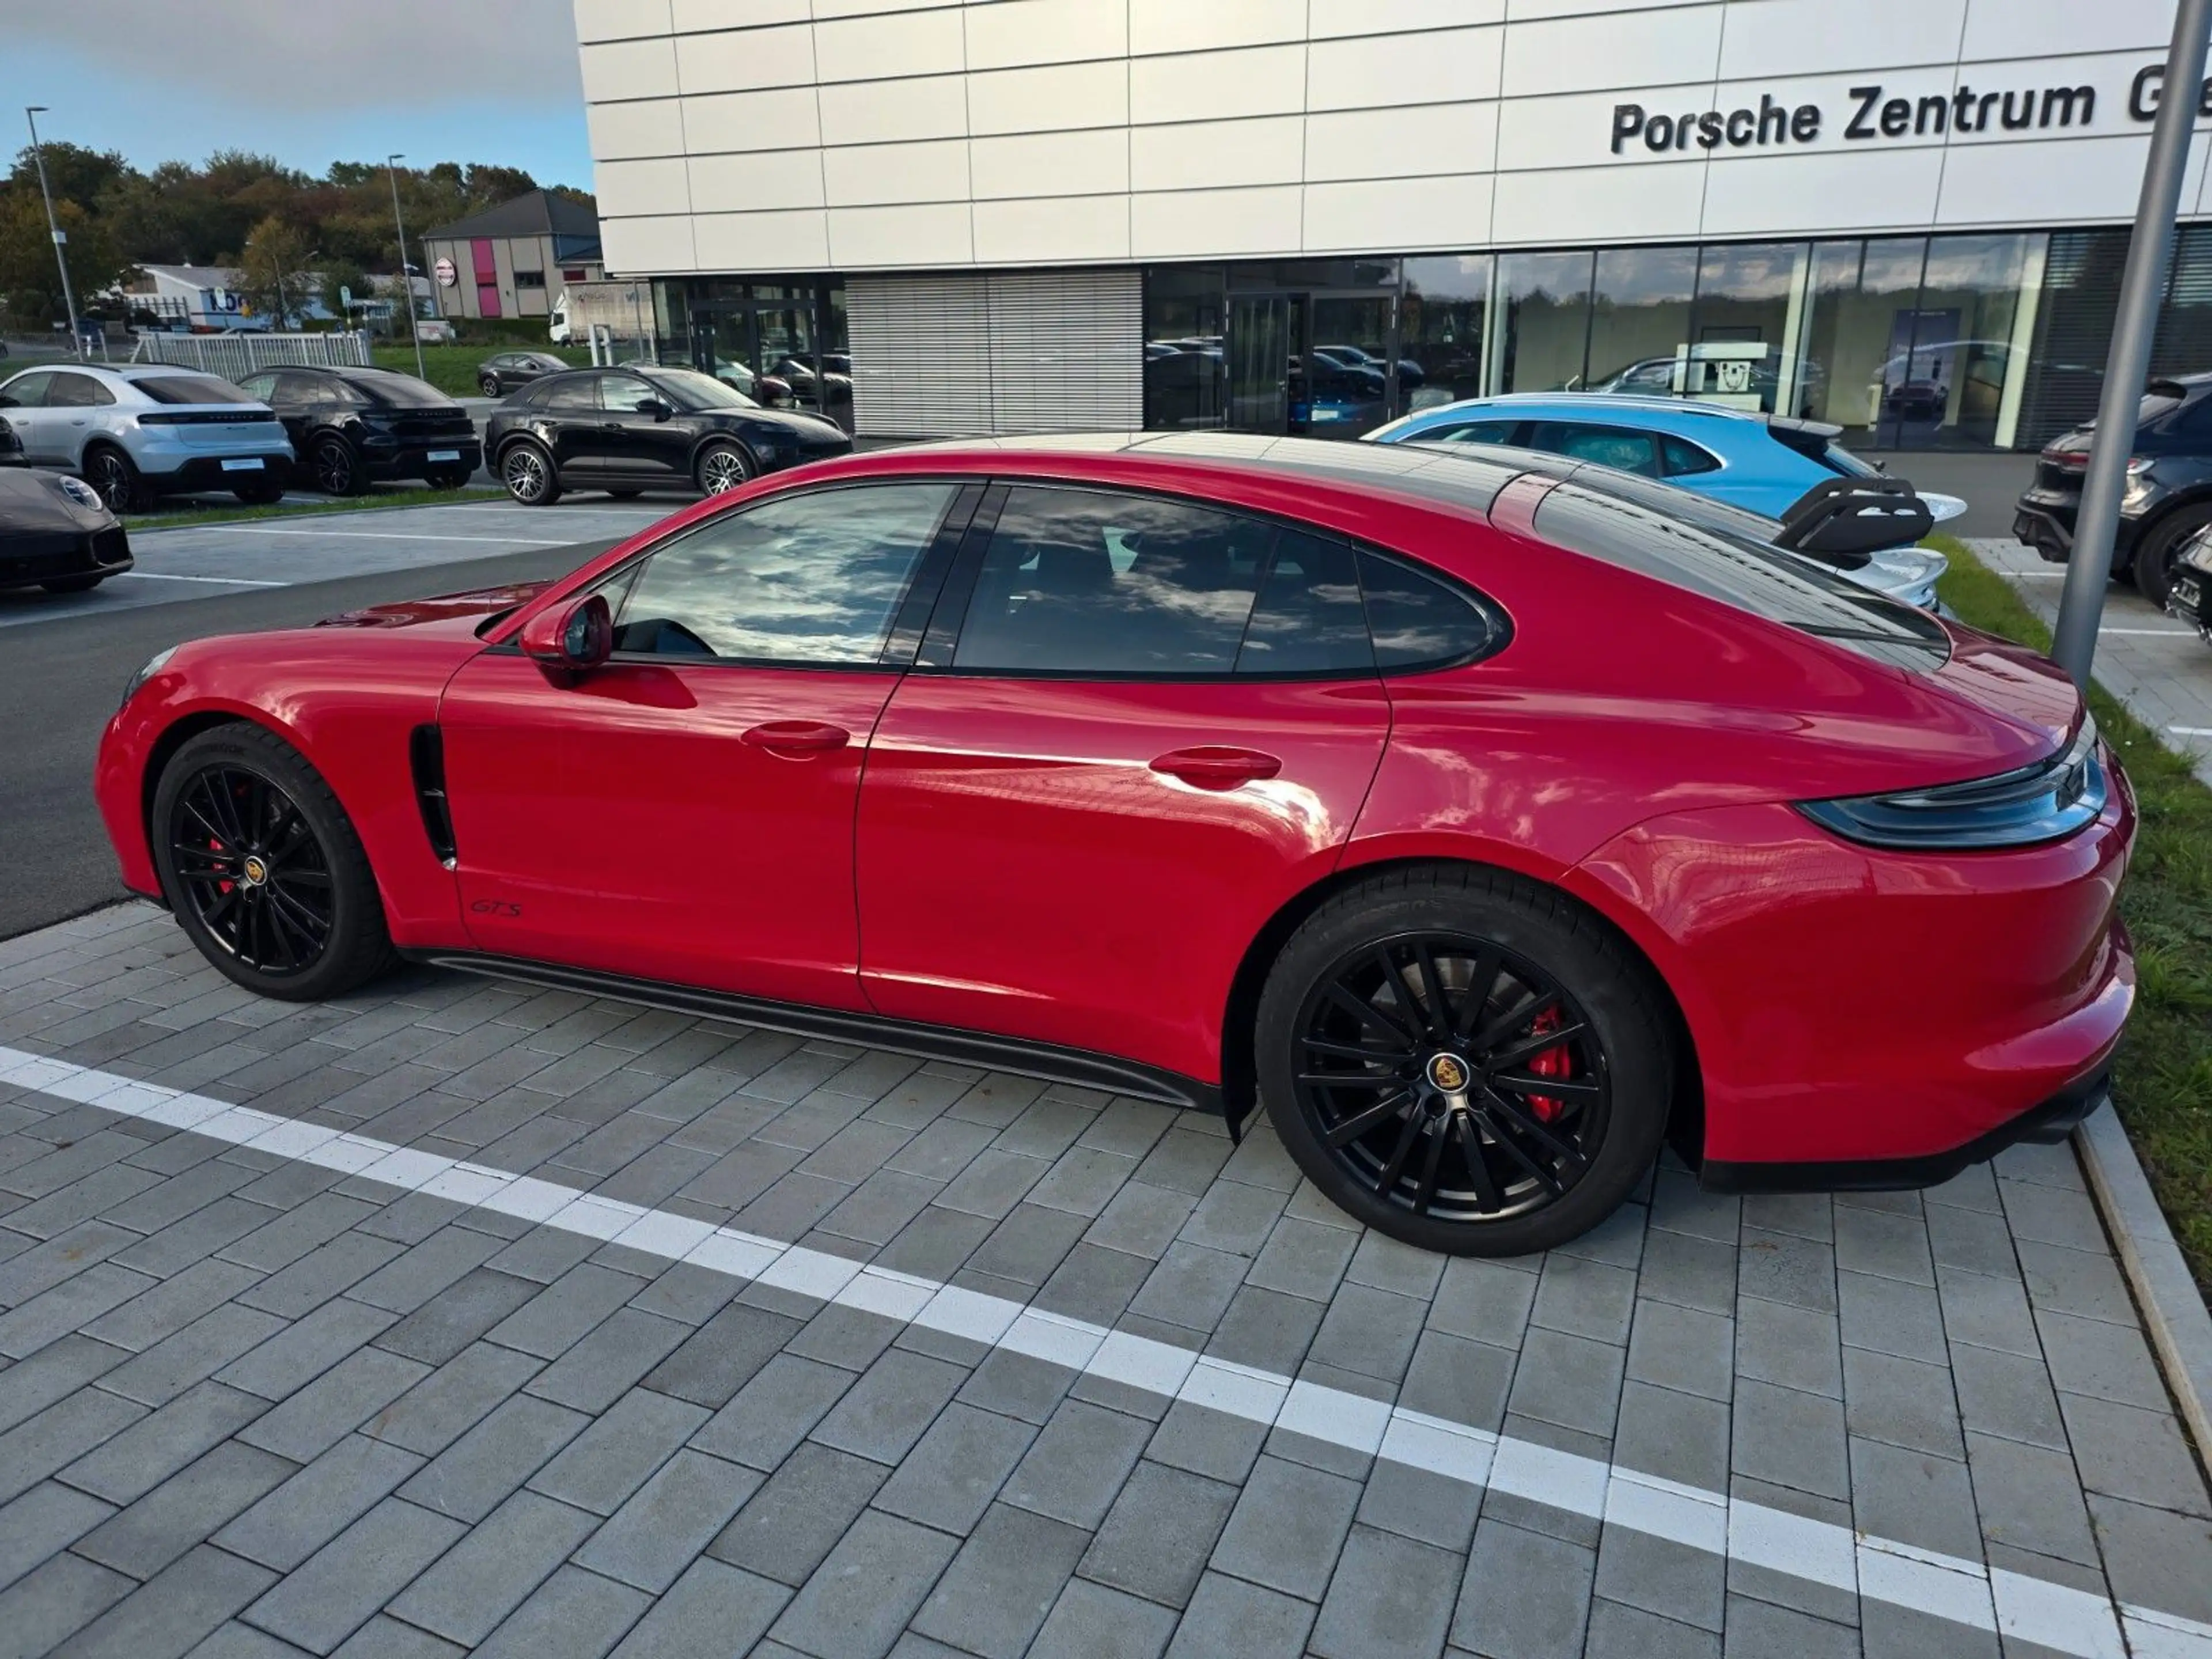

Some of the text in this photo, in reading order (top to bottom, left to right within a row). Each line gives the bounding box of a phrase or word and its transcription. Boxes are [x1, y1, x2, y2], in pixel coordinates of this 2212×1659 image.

[1611, 93, 1820, 153] Porsche
[1844, 85, 2095, 139] Zentrum
[471, 898, 522, 917] GTS
